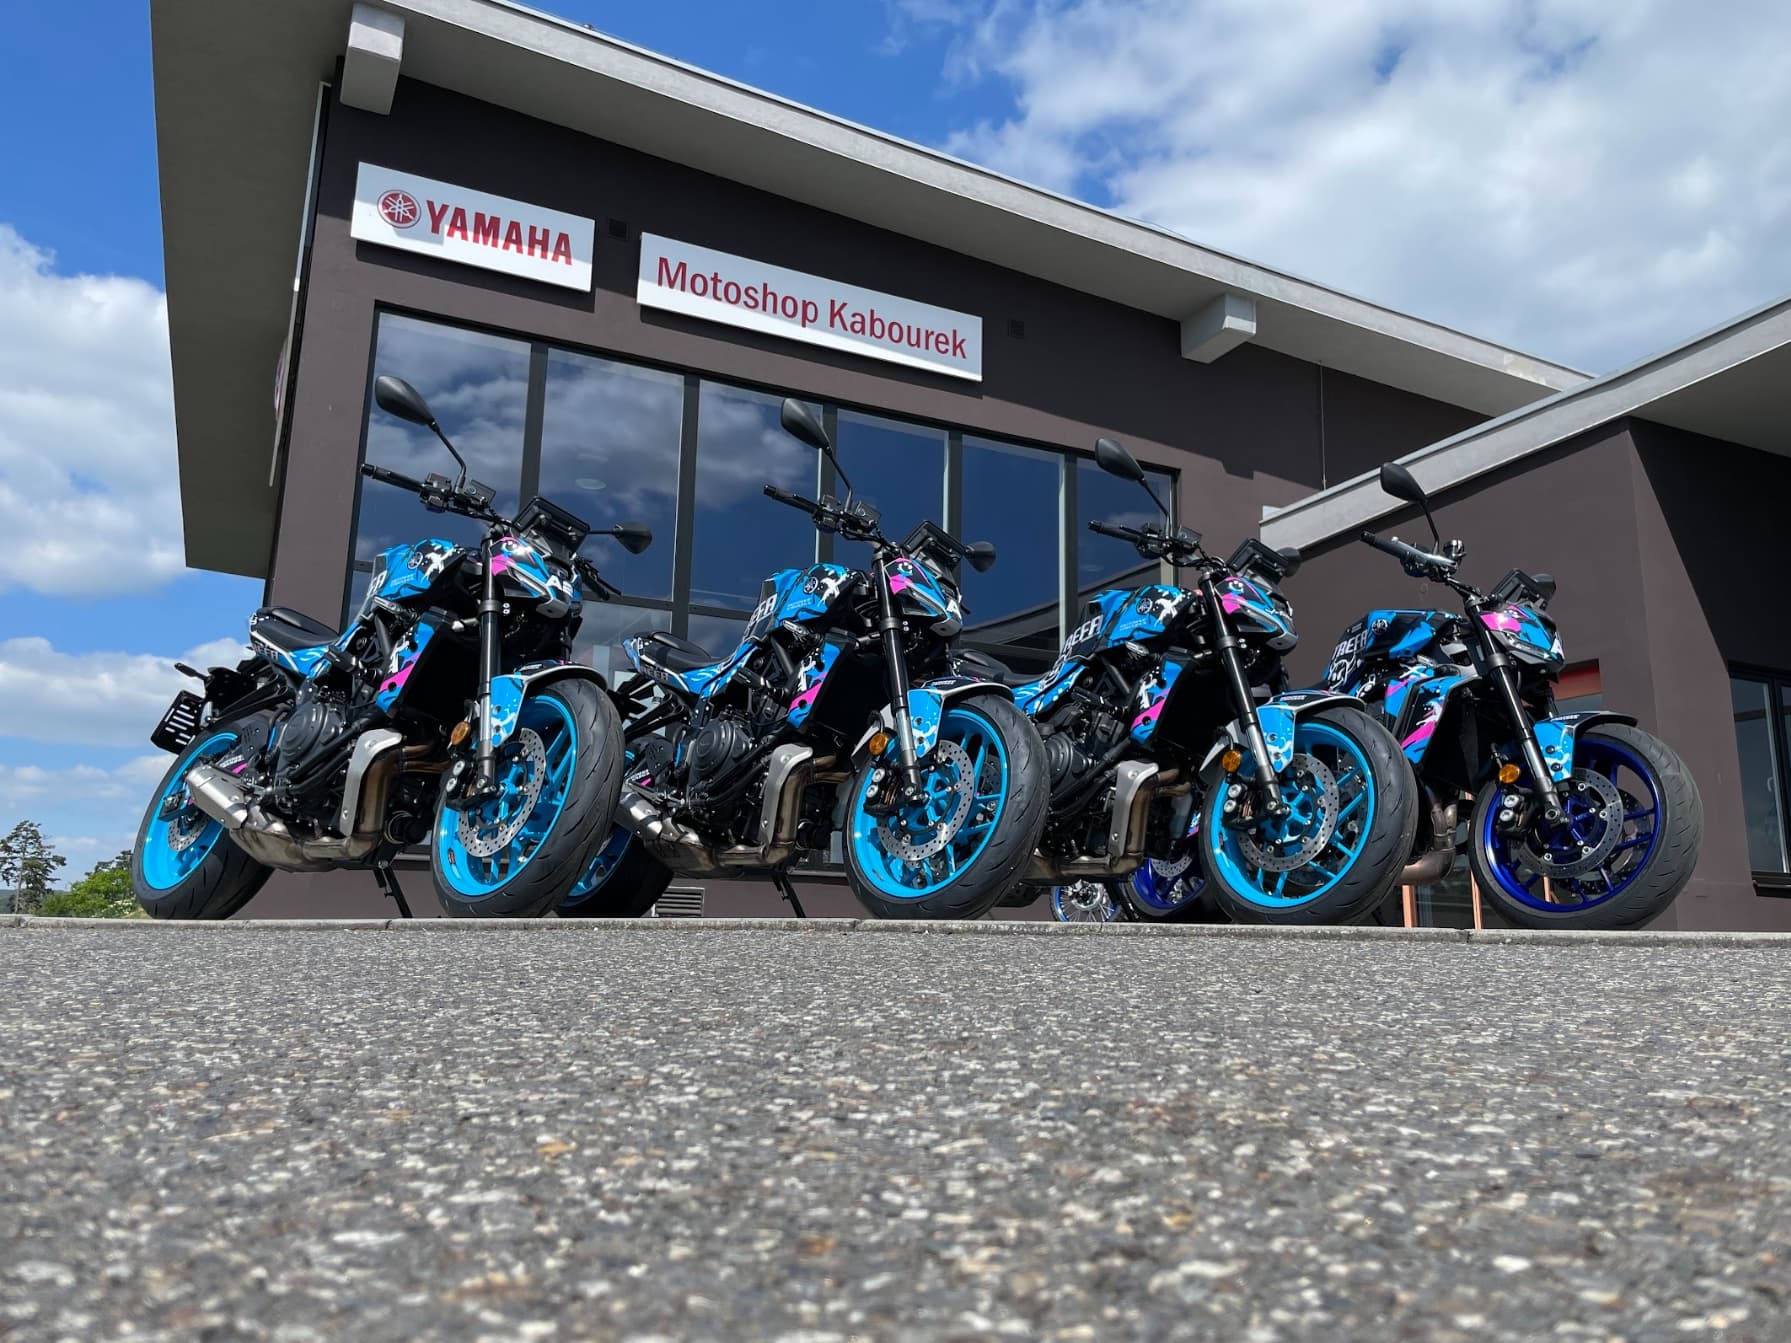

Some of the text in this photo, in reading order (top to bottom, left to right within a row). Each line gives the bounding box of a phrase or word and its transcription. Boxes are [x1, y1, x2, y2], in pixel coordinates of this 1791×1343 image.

[426, 200, 573, 265] YAMAHA
[656, 256, 968, 359] Motoshop Kabourek
